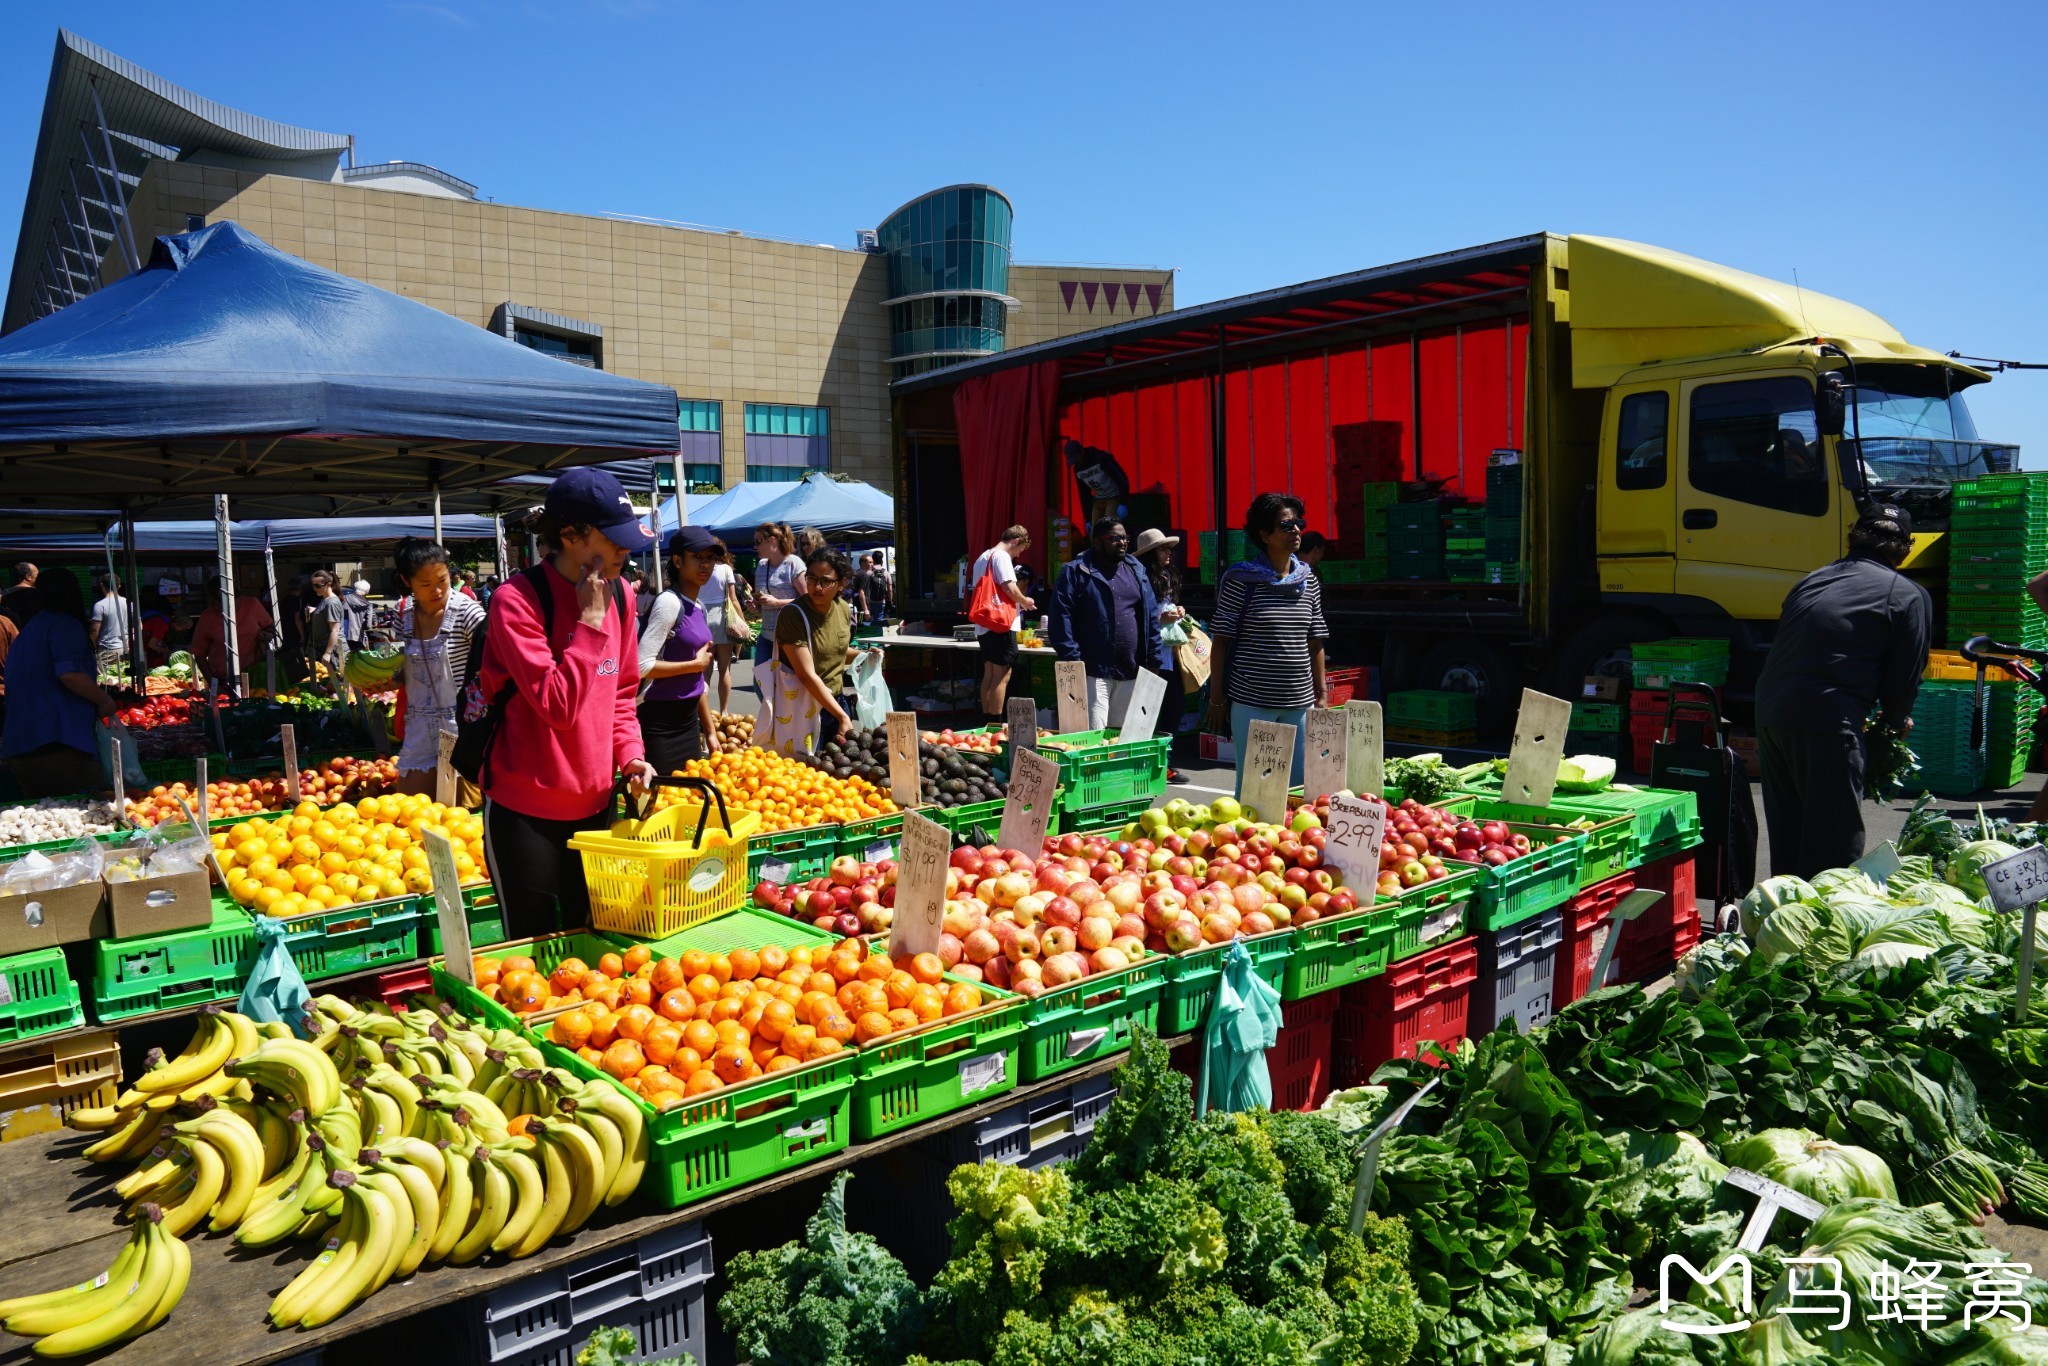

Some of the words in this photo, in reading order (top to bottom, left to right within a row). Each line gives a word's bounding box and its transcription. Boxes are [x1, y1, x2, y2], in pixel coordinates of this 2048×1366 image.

[1311, 709, 1342, 727] ROSE
[1252, 728, 1278, 745] GREEN
[1259, 744, 1283, 756] APPLE
[1017, 748, 1044, 773] ROYAL
[1019, 764, 1043, 787] GALA
